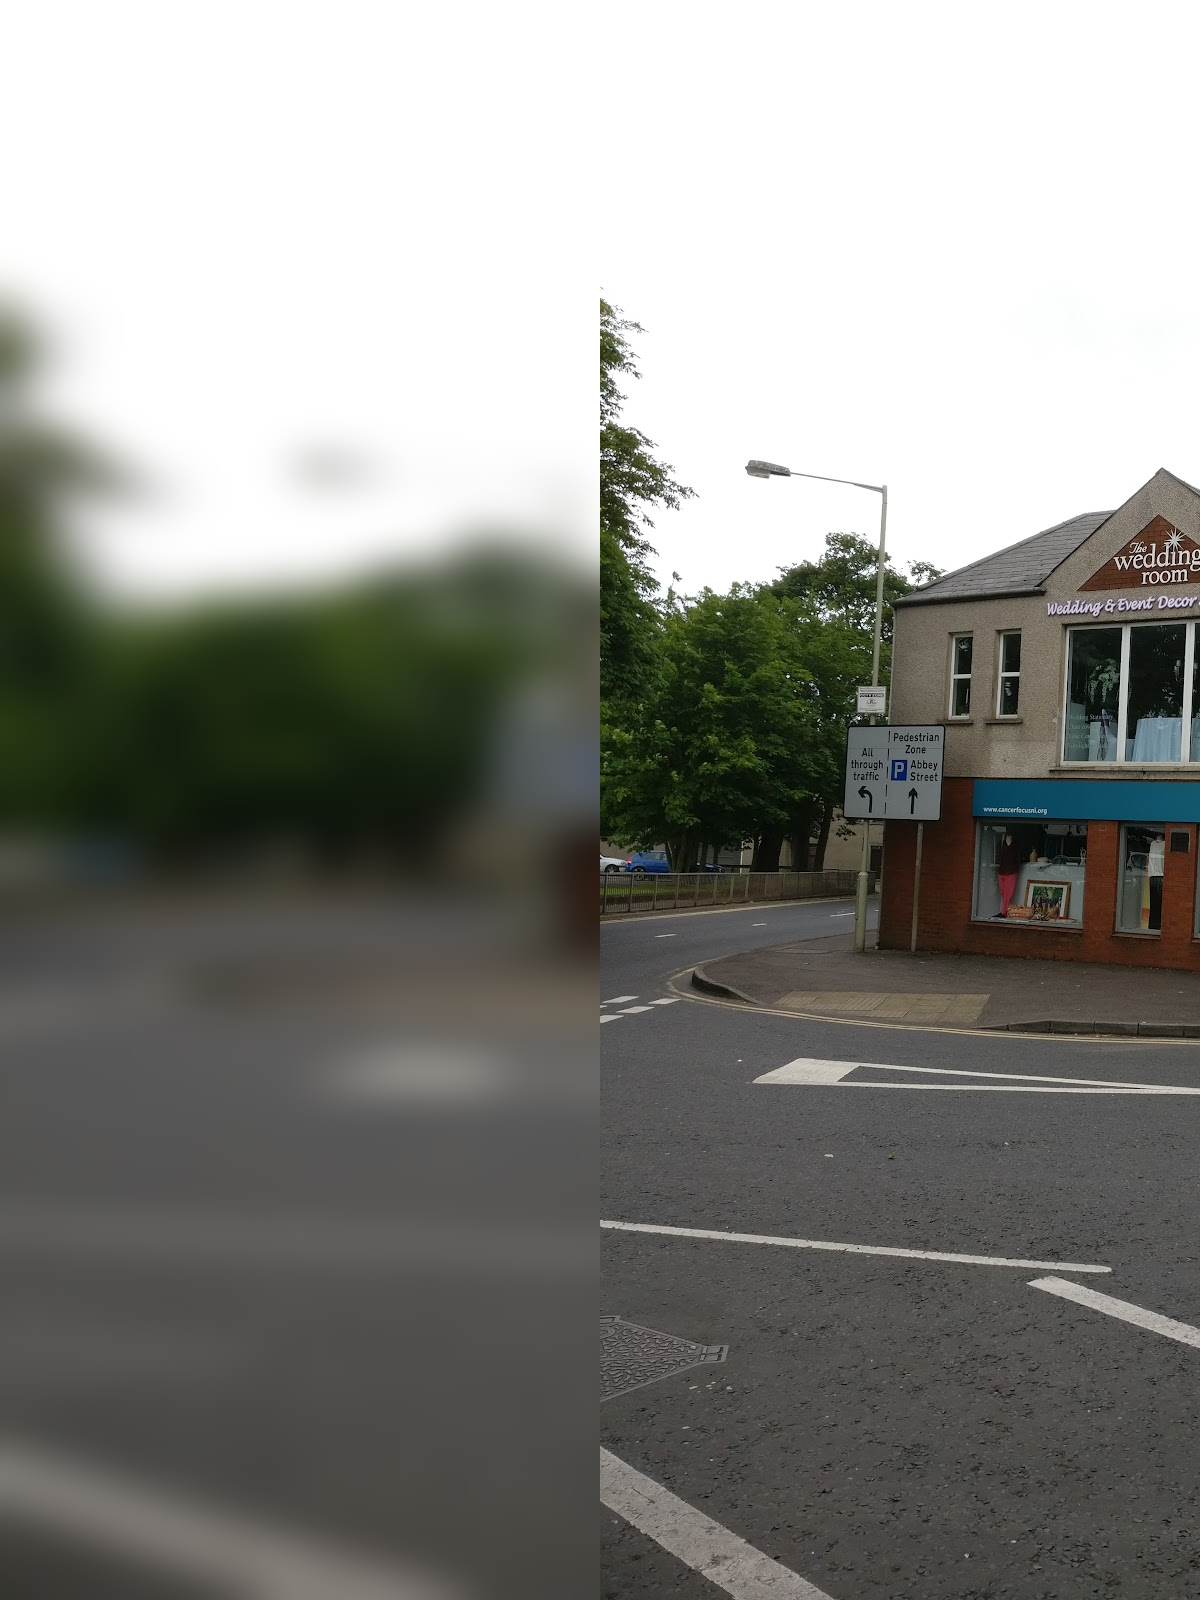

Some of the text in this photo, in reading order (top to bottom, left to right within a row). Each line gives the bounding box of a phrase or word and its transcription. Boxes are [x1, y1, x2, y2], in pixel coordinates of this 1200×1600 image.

[1129, 542, 1147, 554] The
[1141, 567, 1188, 585] room
[1047, 599, 1103, 617] Wedding
[1104, 599, 1115, 612] &
[1117, 596, 1154, 612] Event
[1158, 595, 1197, 610] Decor
[893, 732, 939, 742] Pedestrian
[861, 748, 873, 757] All
[905, 745, 926, 754] Zone
[851, 760, 883, 771] through
[894, 762, 904, 778] P
[910, 760, 938, 771] Abbey
[853, 771, 879, 781] traffic
[910, 772, 938, 782] Street
